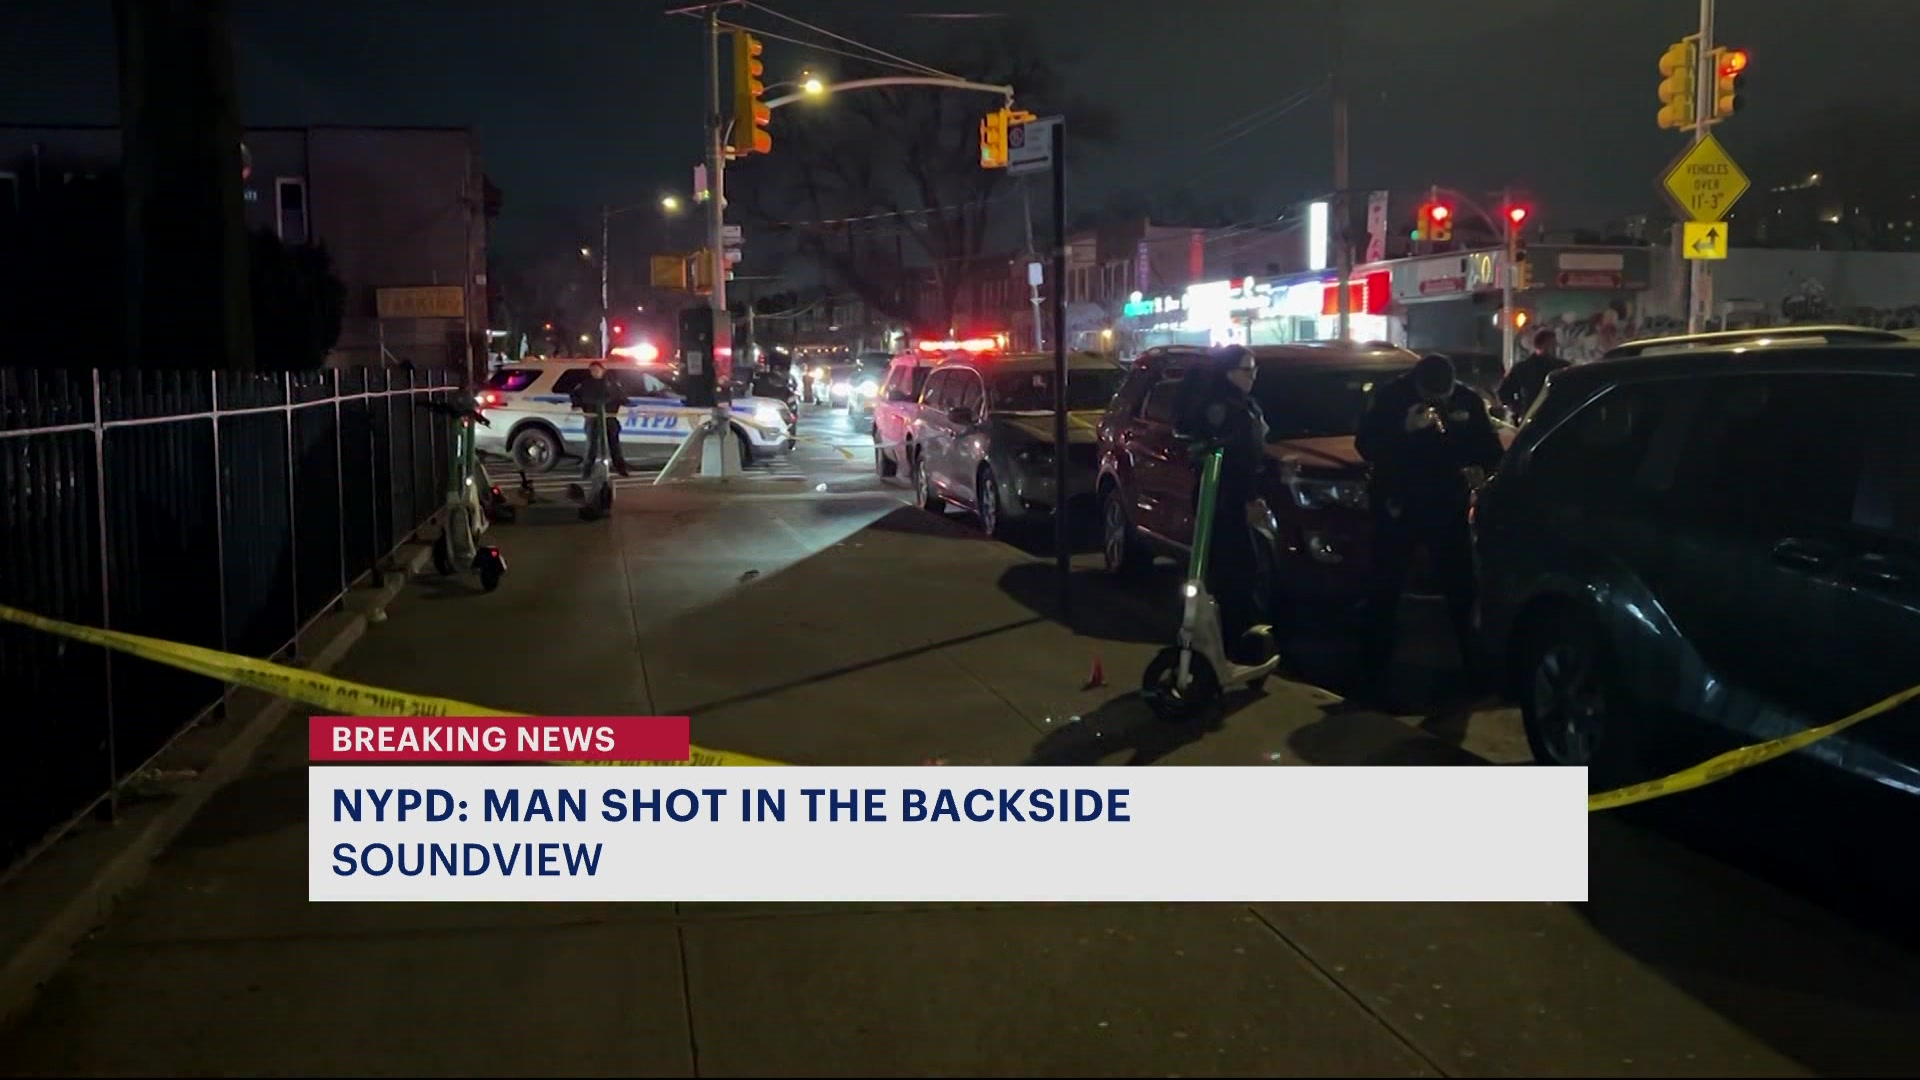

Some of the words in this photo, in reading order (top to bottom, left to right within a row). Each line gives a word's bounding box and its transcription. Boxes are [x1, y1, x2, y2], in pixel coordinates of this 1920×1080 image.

[1686, 164, 1728, 175] VEHICLES
[1694, 179, 1720, 190] OVER
[625, 412, 678, 429] NYPD
